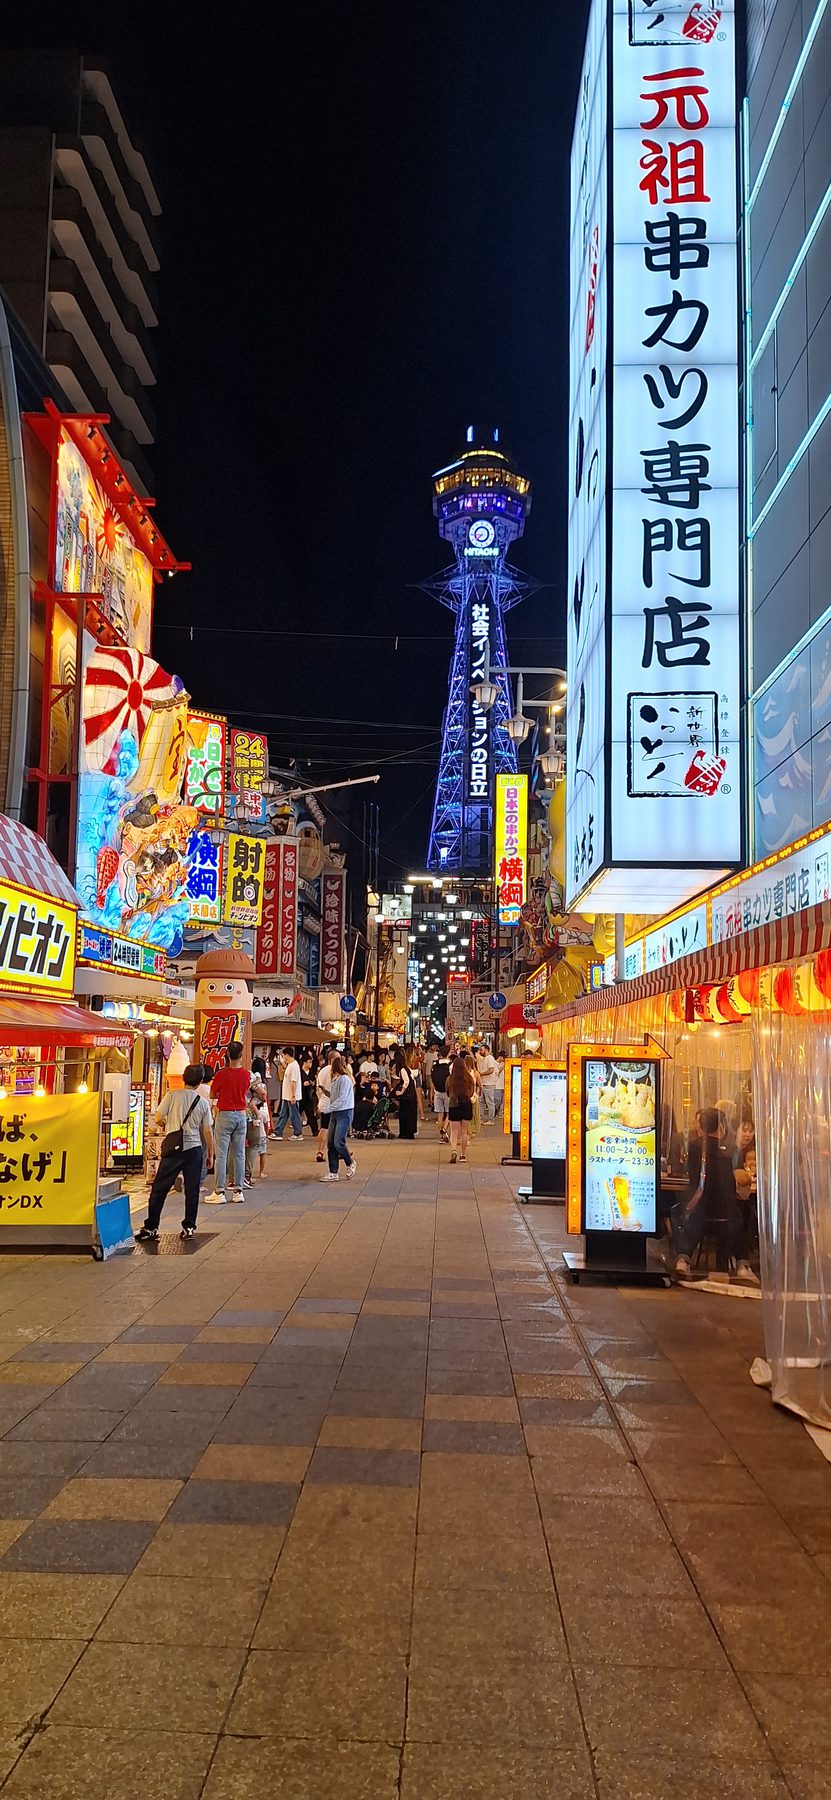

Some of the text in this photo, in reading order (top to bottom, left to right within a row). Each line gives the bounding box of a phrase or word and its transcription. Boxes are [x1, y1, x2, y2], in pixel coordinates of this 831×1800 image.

[639, 67, 712, 668] 元祖串カツ専門店
[464, 547, 499, 556] HITACHI
[470, 604, 489, 796] 社会イノベションの日立
[235, 734, 264, 757] 24
[686, 706, 707, 748] 新世界
[505, 788, 518, 856] 日本一の串かつ
[232, 838, 262, 906] 射的
[499, 858, 524, 906] 横綱
[189, 902, 217, 919] 天閣店
[230, 913, 258, 922] チャンピオン
[0, 1113, 38, 1142] ば、
